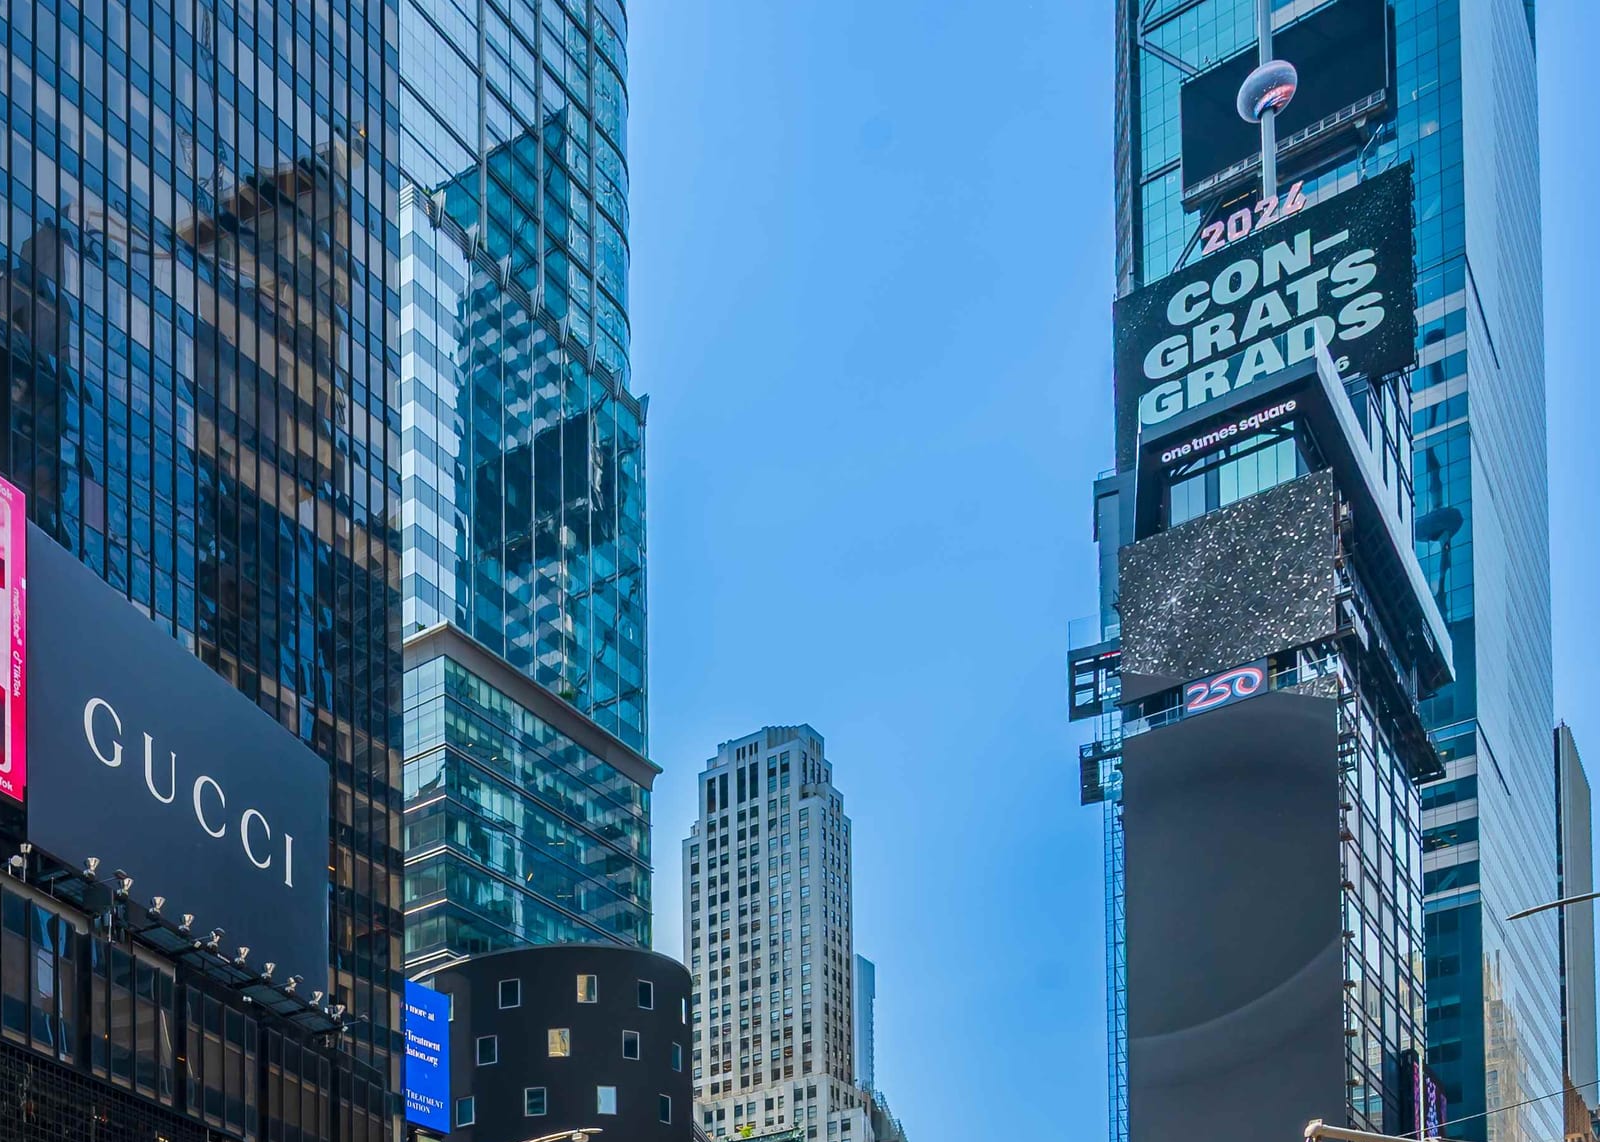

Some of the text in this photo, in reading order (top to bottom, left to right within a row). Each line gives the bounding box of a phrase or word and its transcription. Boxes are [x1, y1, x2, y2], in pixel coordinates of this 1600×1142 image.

[1143, 249, 1377, 379] GRATS
[1166, 229, 1349, 326] CON-
[1141, 292, 1385, 425] GRADS
[1162, 400, 1297, 463] one times square
[1186, 666, 1264, 713] 250
[84, 697, 294, 889] GUCCI
